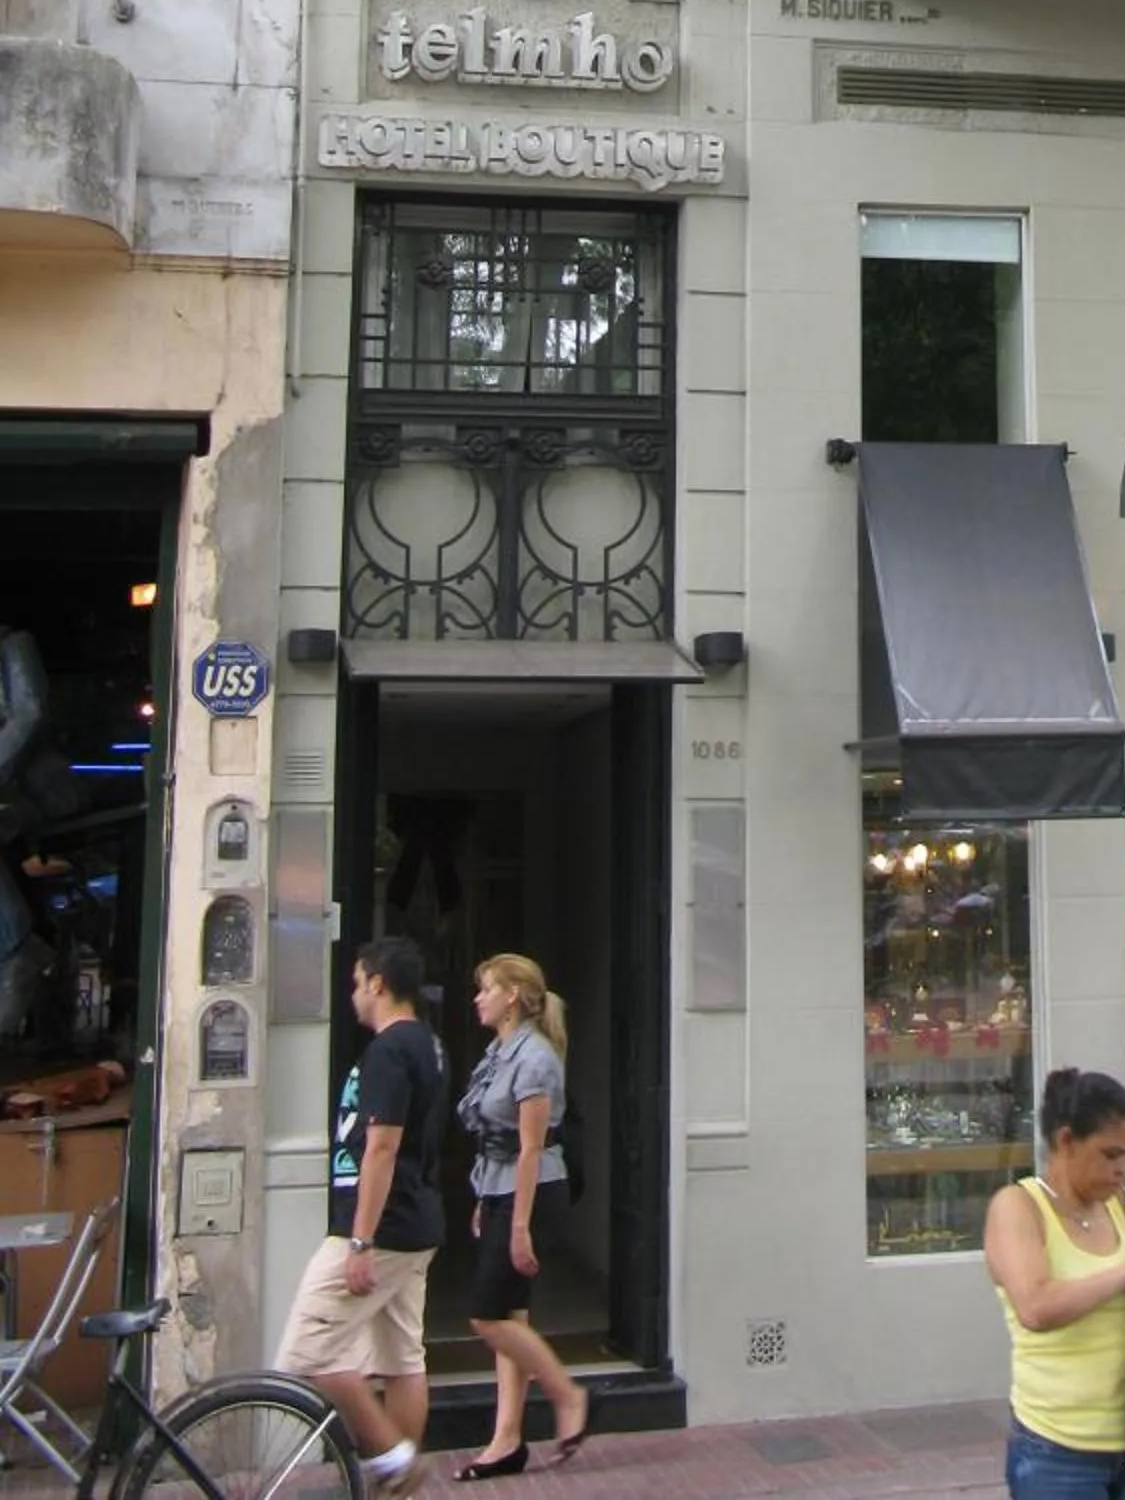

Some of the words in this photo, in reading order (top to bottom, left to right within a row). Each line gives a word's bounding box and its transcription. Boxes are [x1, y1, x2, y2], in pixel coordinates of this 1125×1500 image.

[377, 6, 673, 92] telmho
[318, 114, 476, 173] HOTEL
[480, 120, 725, 192] BOUTIQUE
[203, 665, 257, 697] USS
[691, 740, 741, 760] 1086
